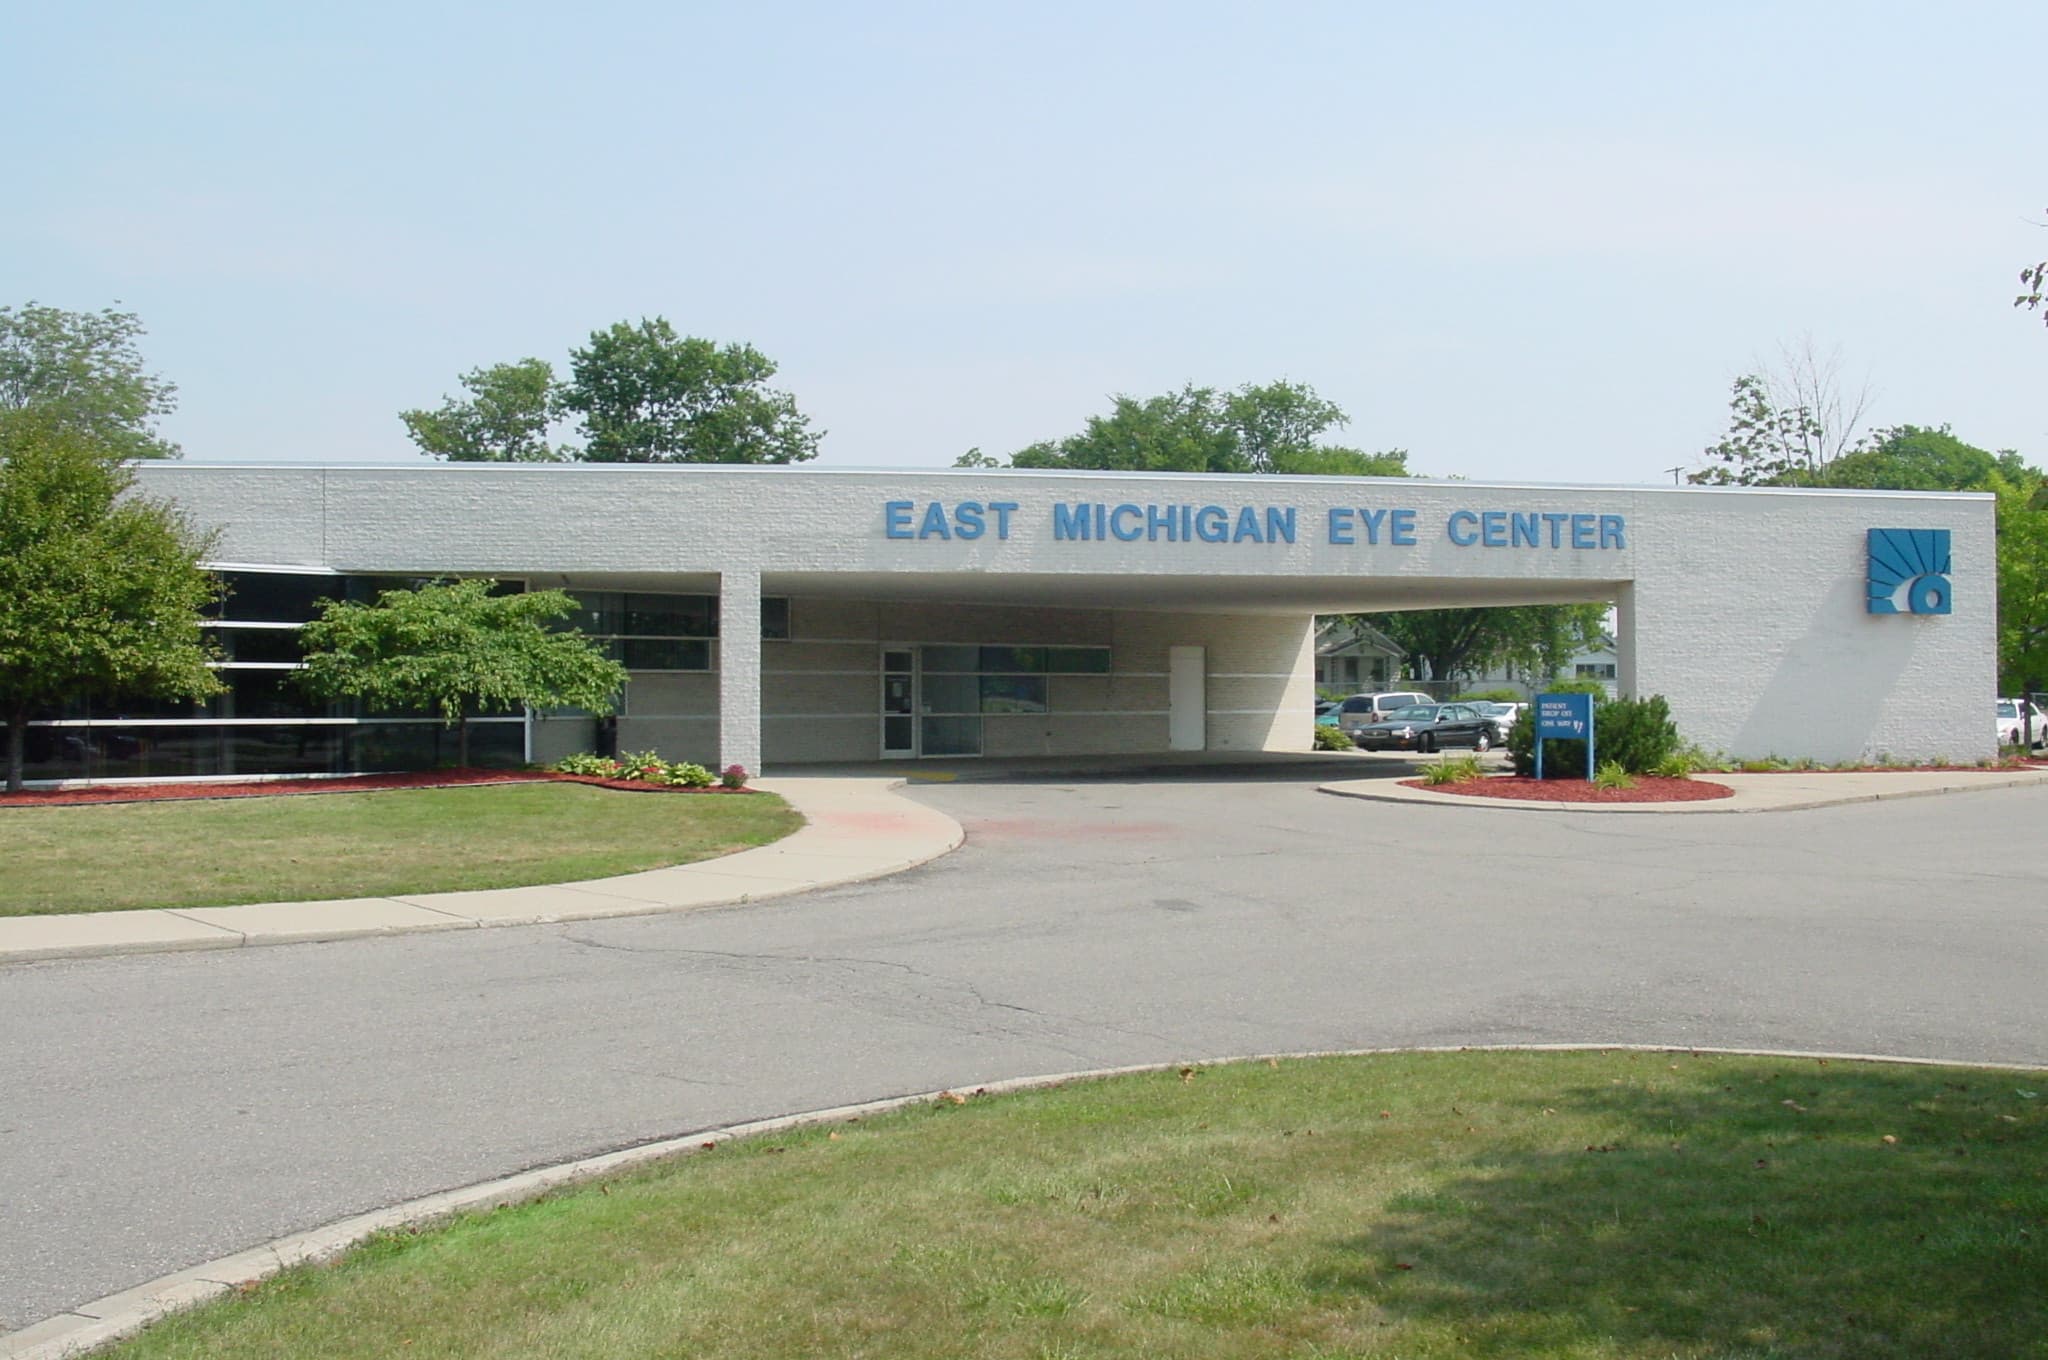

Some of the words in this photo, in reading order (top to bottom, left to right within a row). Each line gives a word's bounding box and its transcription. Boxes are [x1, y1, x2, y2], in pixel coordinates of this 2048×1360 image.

[886, 501, 1018, 540] EAST
[1054, 503, 1296, 544] MICHIGAN
[1328, 508, 1417, 546] EYE
[1448, 510, 1625, 549] CENTER
